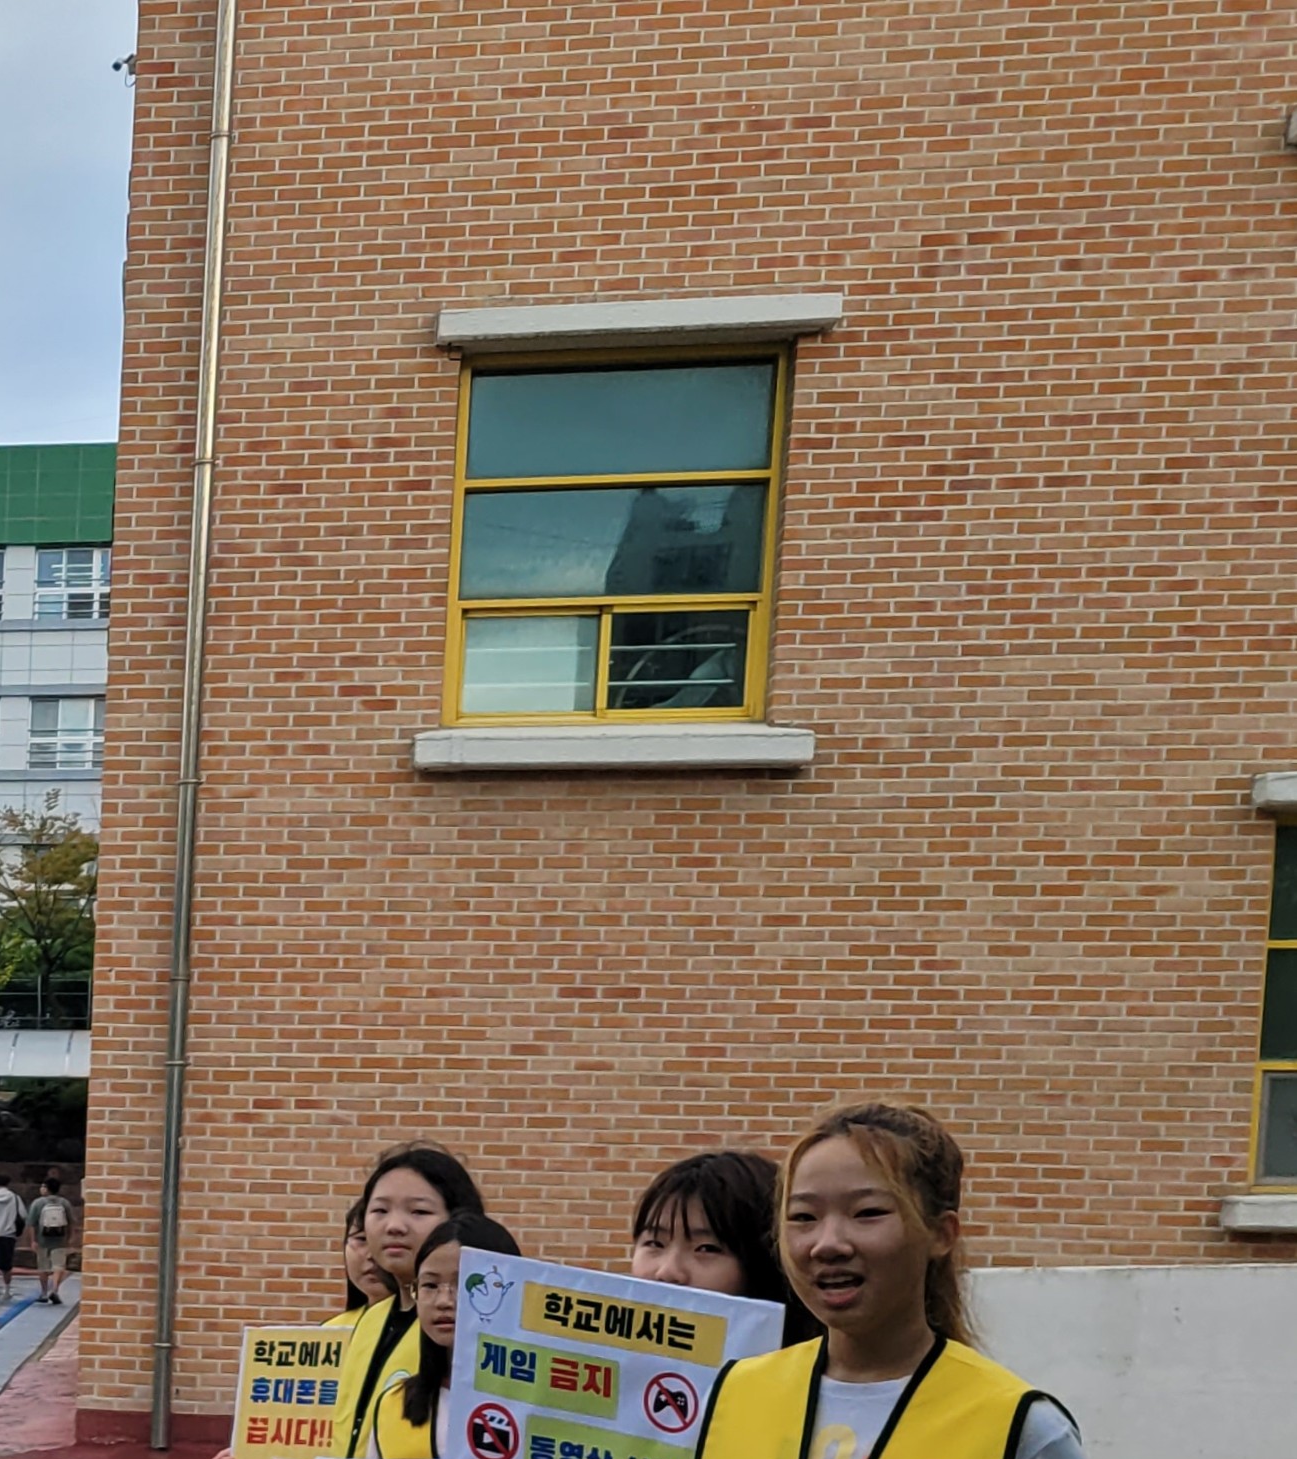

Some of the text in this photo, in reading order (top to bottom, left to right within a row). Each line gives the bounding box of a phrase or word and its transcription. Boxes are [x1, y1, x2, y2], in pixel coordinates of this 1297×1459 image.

[544, 1292, 696, 1351] 학교에서는
[253, 1340, 342, 1368] 학교에서
[481, 1341, 613, 1398] 게임 금지
[250, 1377, 338, 1405] 휴대폰을
[246, 1417, 333, 1448] 끕시다!!
